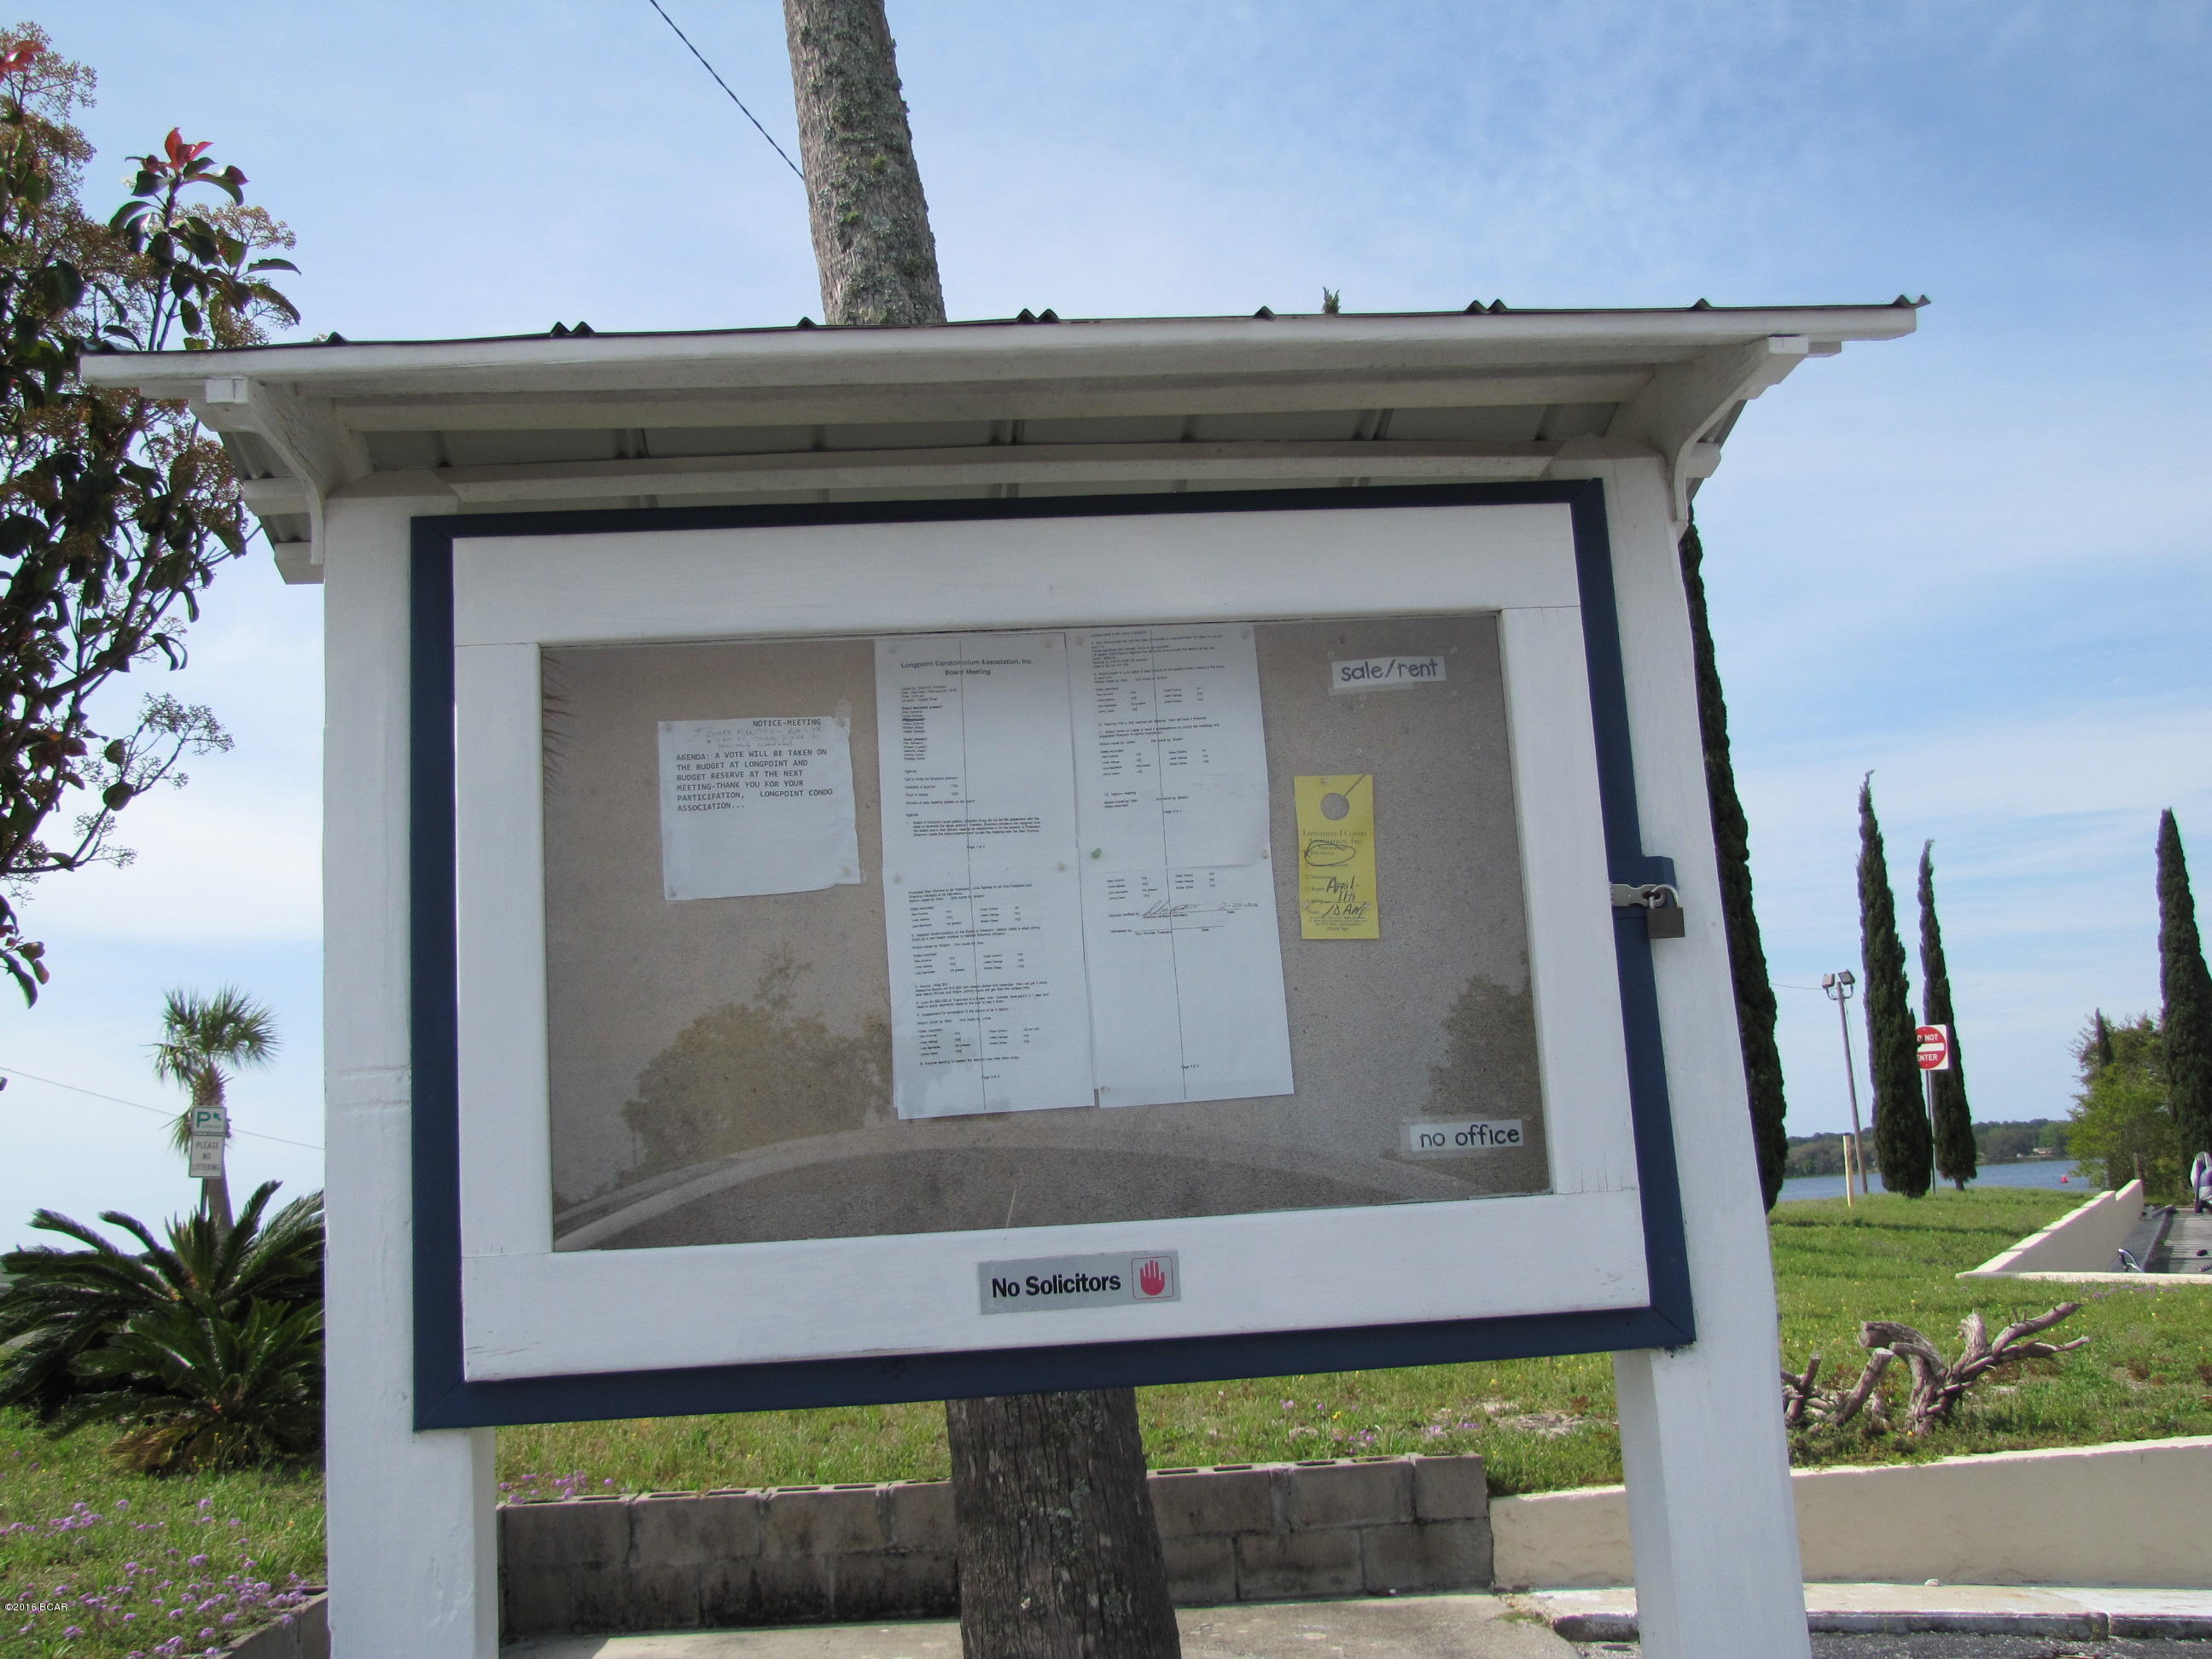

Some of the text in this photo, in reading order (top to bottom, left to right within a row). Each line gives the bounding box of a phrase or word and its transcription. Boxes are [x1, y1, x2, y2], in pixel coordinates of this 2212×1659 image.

[900, 661, 934, 669] Longpoint
[1341, 658, 1438, 682] sale/rent
[753, 719, 821, 727] NOTICE-MEETING
[676, 753, 710, 761] AGENDA:
[696, 761, 725, 771] BUDGET
[710, 771, 744, 779] RESERVE
[677, 791, 745, 801] PARTICIPATION,
[808, 788, 833, 796] CONDO
[1419, 1124, 1520, 1148] no office
[196, 1141, 219, 1150] PLEASE
[992, 1272, 1121, 1297] No Solicitors
